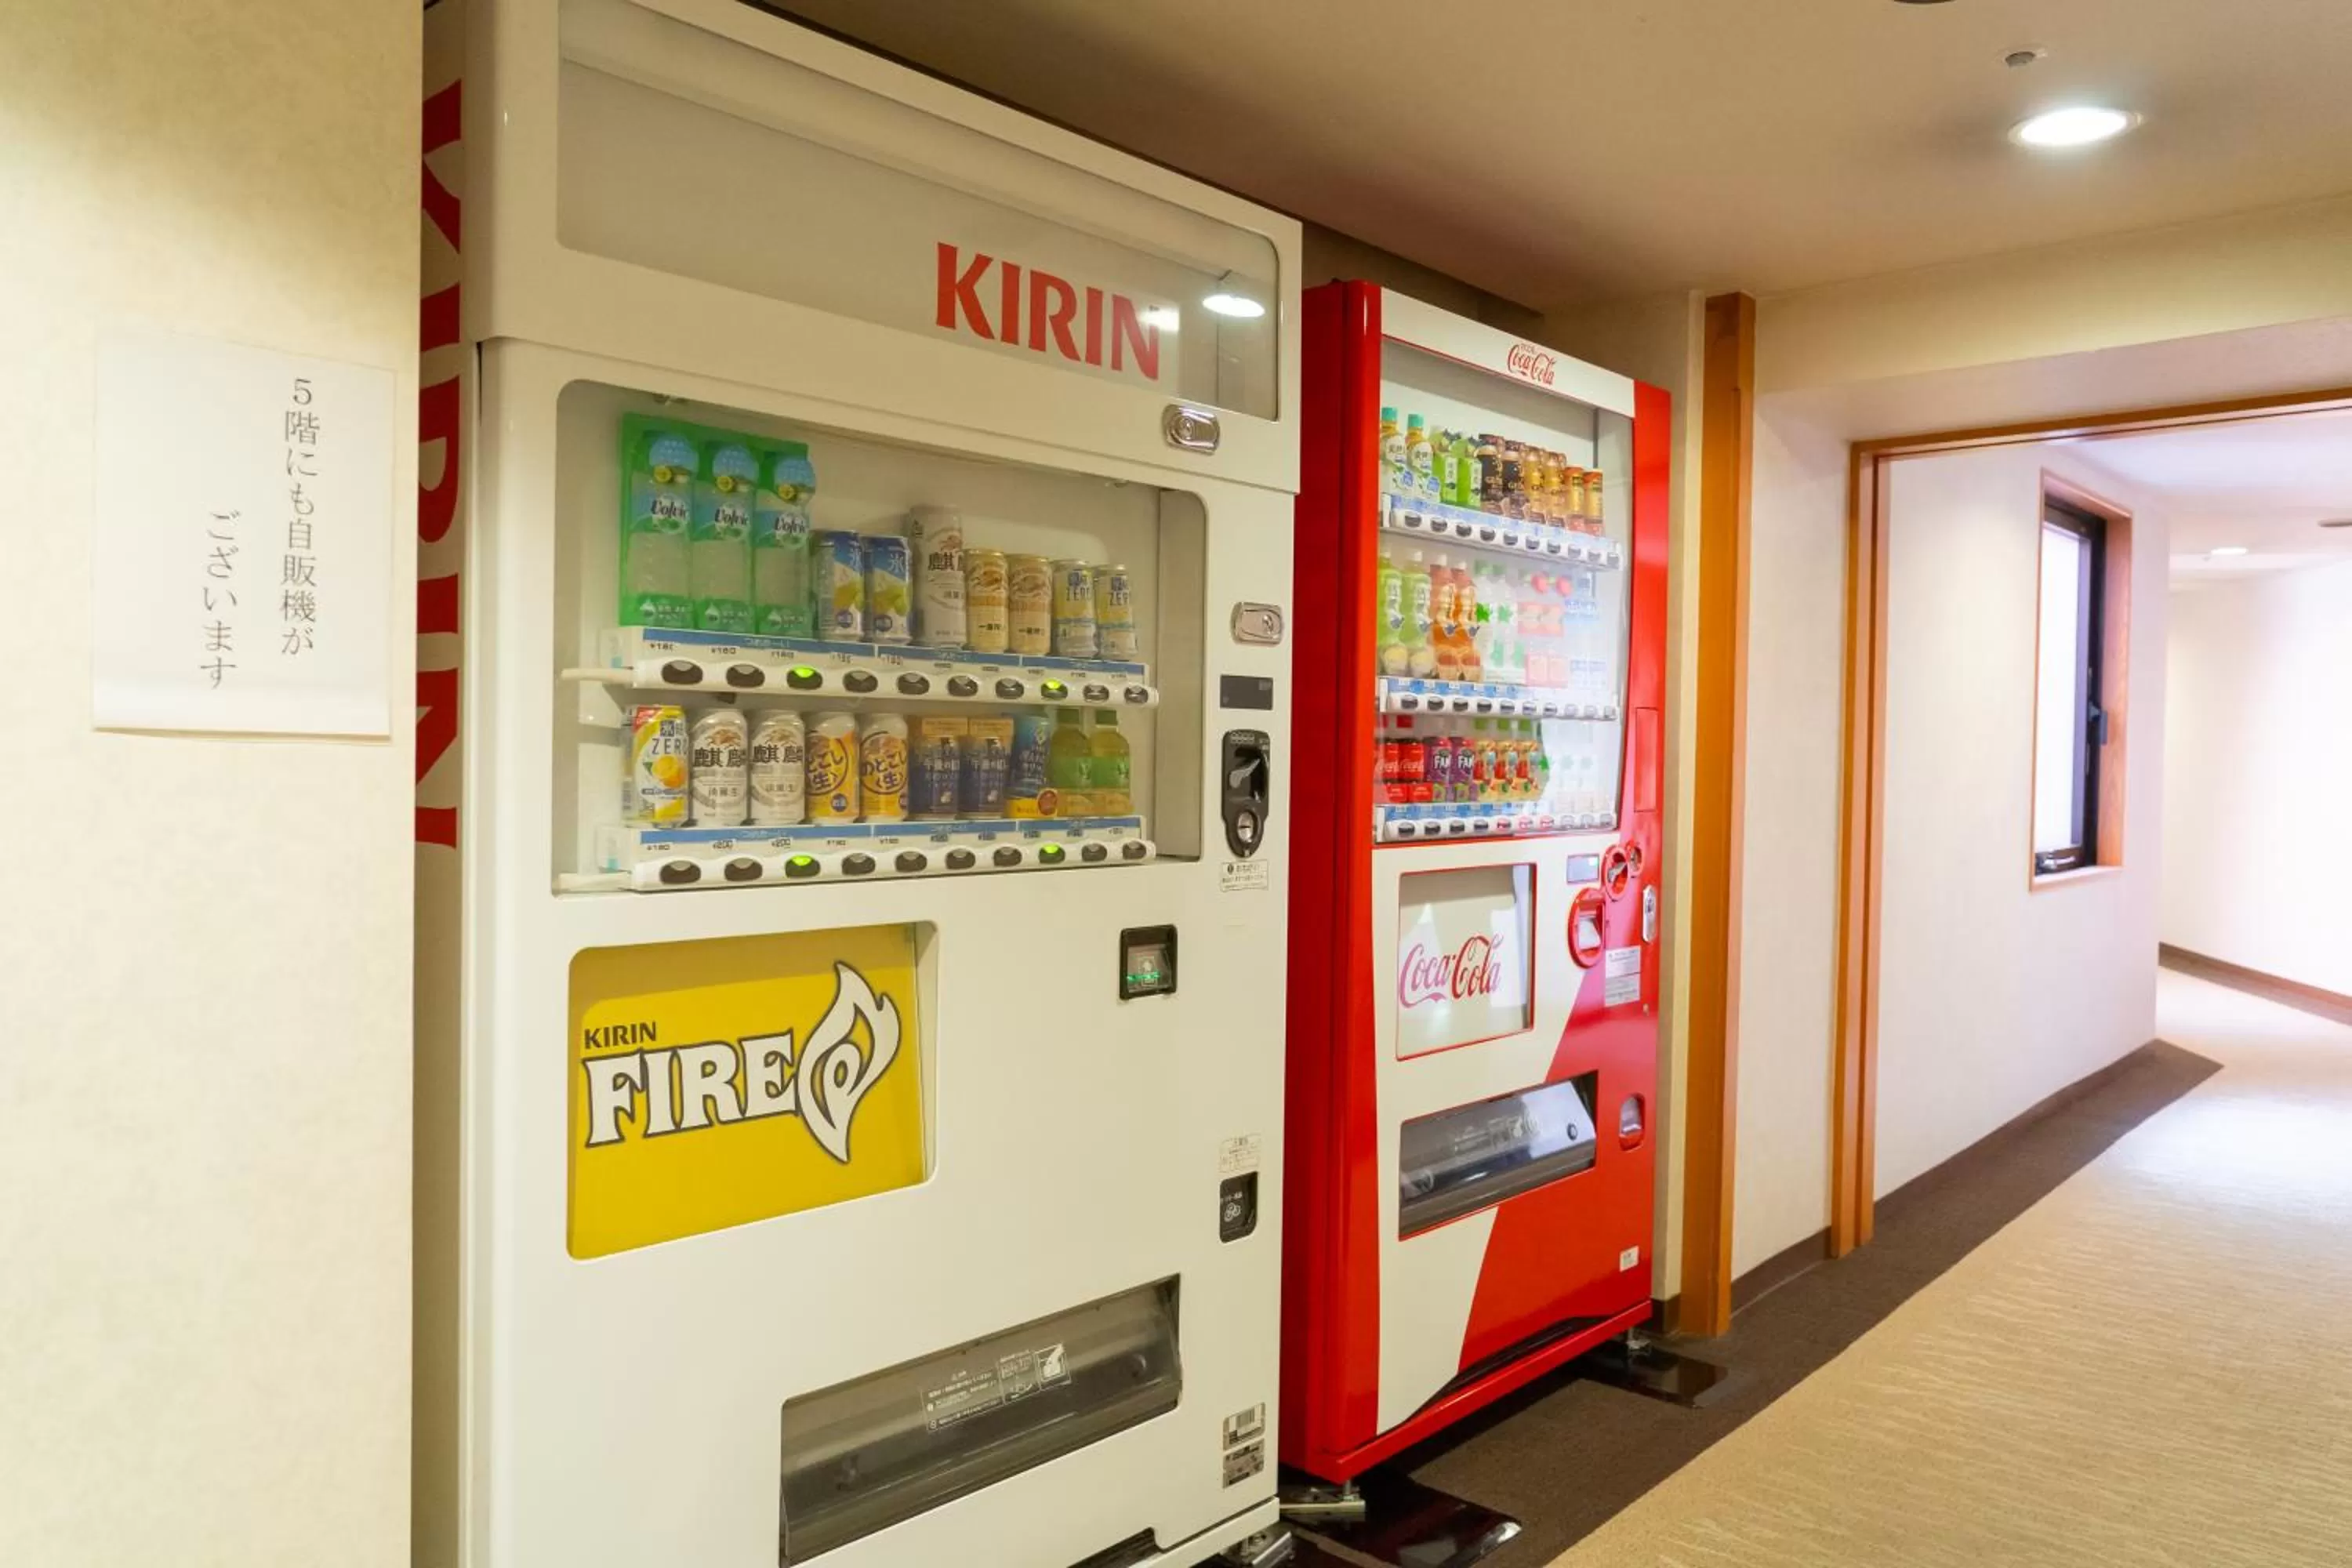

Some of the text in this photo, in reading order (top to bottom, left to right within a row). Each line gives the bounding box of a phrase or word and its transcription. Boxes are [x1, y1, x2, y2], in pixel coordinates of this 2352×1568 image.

[936, 241, 1160, 380] KIRIN
[278, 378, 320, 656] 5階にも自販機が
[200, 510, 241, 690] ございます
[584, 1021, 657, 1050] KIRIN
[1399, 932, 1504, 1009] Coca-Cola
[581, 1028, 800, 1149] FIRE
